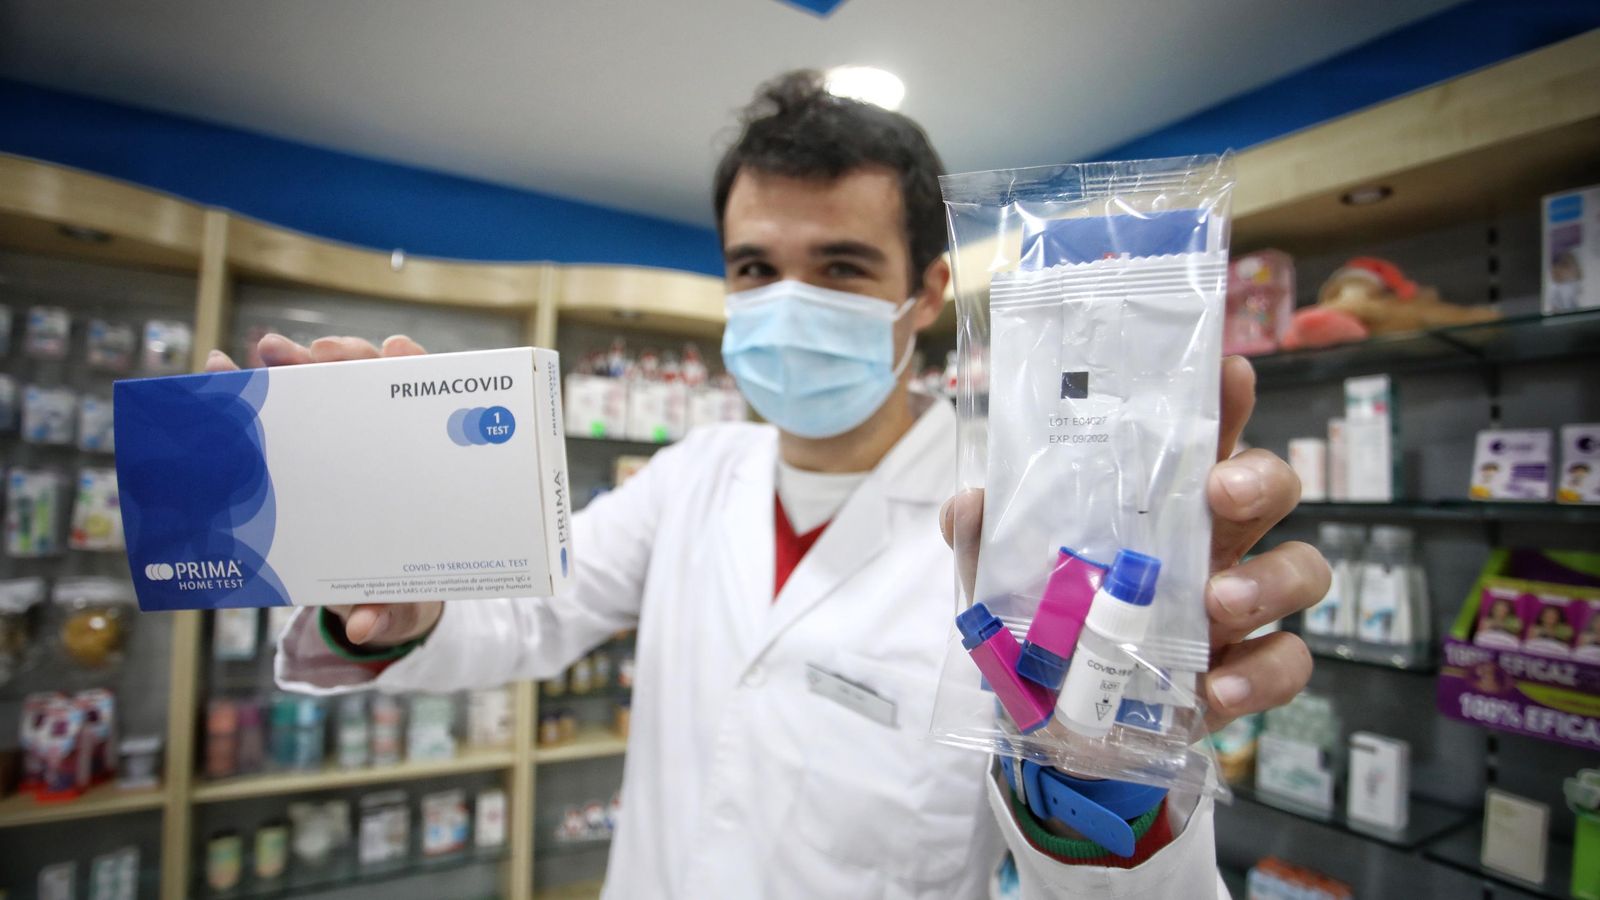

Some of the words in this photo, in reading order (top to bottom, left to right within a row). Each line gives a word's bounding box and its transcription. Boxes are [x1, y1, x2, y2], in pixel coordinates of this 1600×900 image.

[390, 375, 514, 399] PRIMACOVID
[547, 361, 557, 436] PRIMACOVID
[493, 411, 501, 424] 1
[1049, 417, 1070, 426] LOT
[486, 425, 510, 436] TEST
[1049, 434, 1070, 444] EXP
[554, 471, 566, 543] PRIMA
[175, 560, 242, 580] PRIMA
[403, 563, 445, 573] COVID-19
[447, 560, 506, 571] SEROLOGICAL
[508, 558, 528, 568] TEST
[178, 580, 214, 591] HOME
[216, 578, 244, 589] TEST
